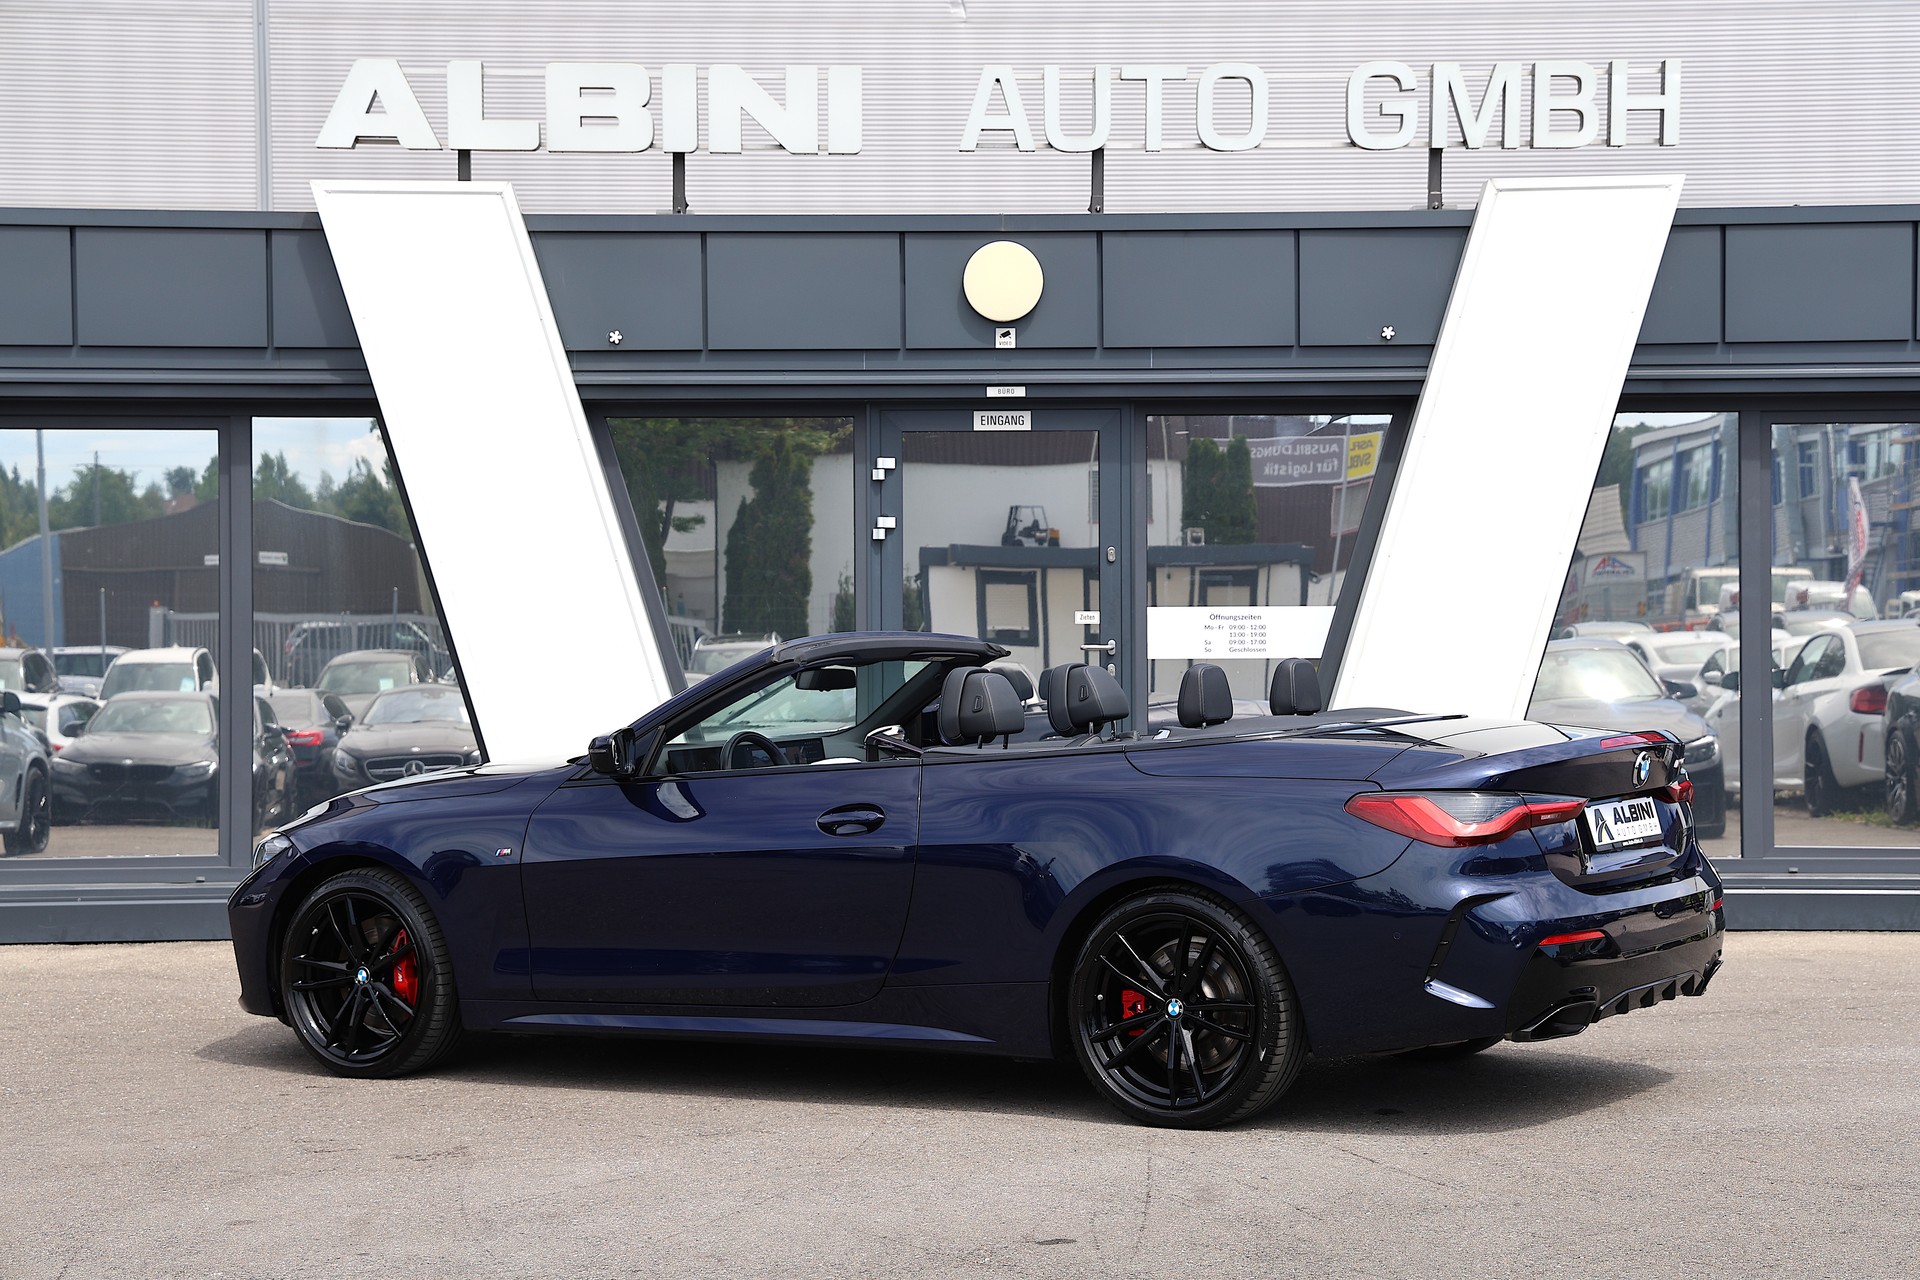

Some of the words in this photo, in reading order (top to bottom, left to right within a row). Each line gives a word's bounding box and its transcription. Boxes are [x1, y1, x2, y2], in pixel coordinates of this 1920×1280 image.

[315, 58, 862, 155] ALBINI
[959, 62, 1269, 152] AUTO
[1345, 59, 1682, 150] GMBH
[997, 387, 1015, 395] BÜRO
[980, 415, 1025, 426] EINGANG
[1209, 613, 1262, 621] Öffnungszeiten
[1612, 801, 1655, 825] ALBINI
[1616, 825, 1637, 837] AUTO
[1638, 822, 1659, 834] GMBH
